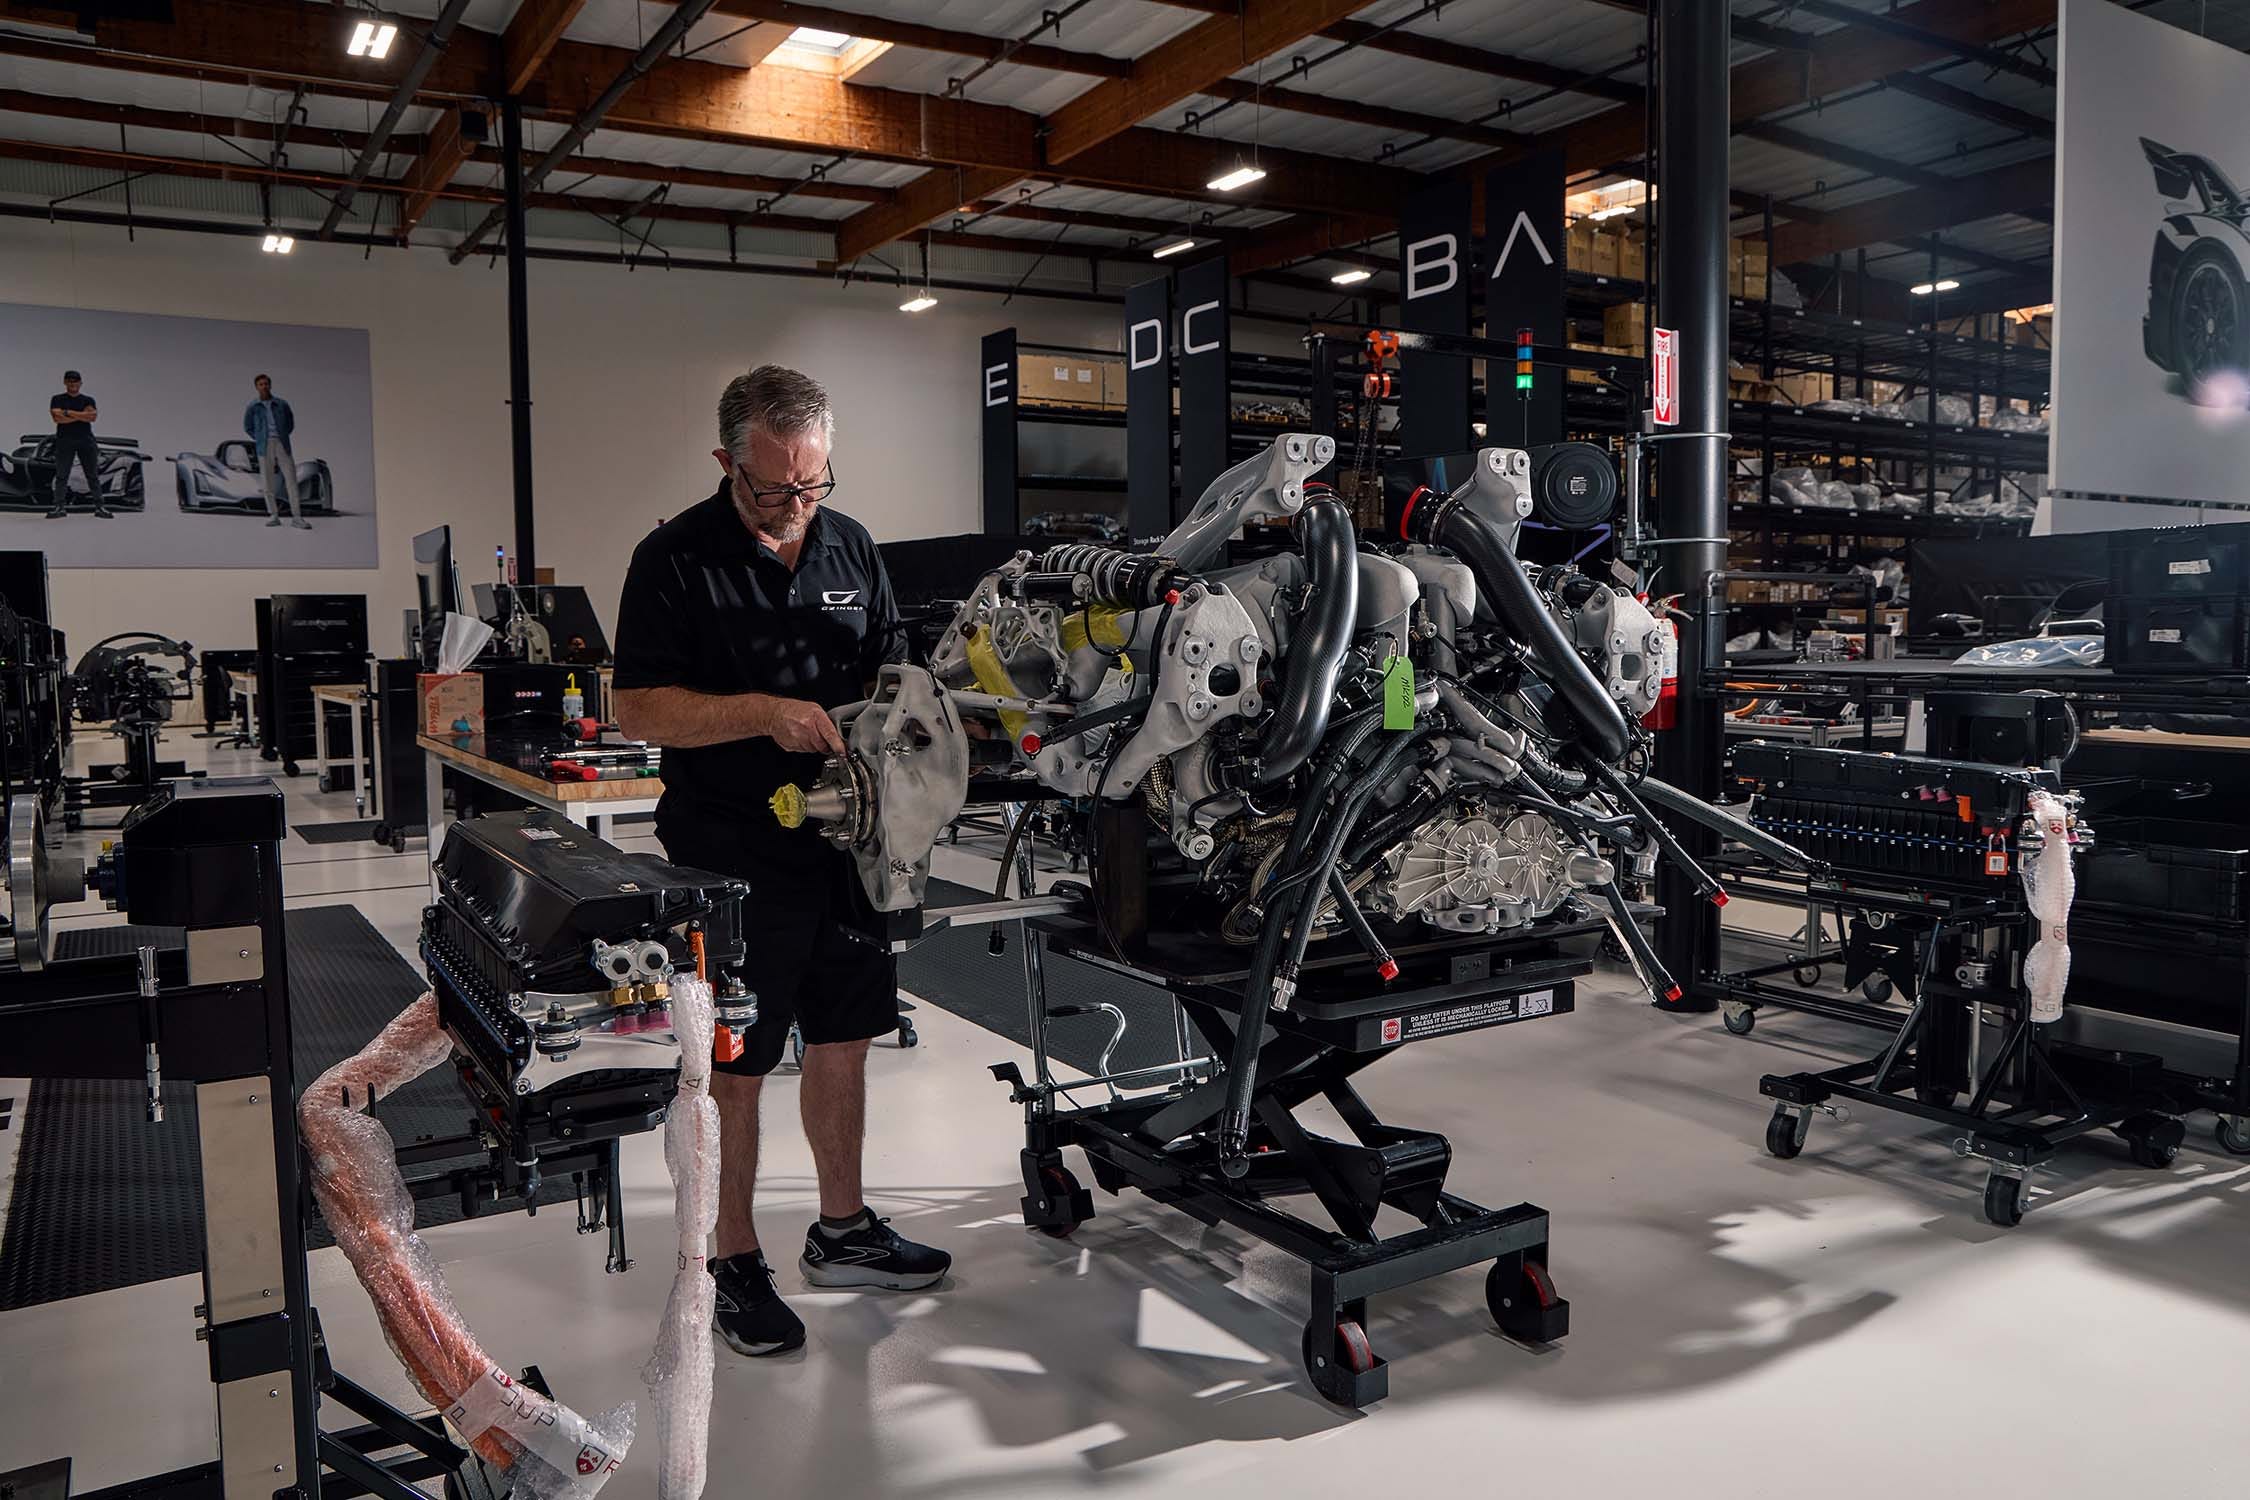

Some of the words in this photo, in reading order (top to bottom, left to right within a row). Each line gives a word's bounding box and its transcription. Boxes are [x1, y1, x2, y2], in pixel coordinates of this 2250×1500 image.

[1407, 234, 1458, 300] B
[1130, 318, 1162, 371] D
[1183, 300, 1220, 355] C
[985, 362, 1009, 408] E
[1385, 1026, 1397, 1035] STOP
[1412, 1018, 1433, 1027] UNLESS
[1447, 1008, 1486, 1021] MECHANICALLY
[1488, 1004, 1509, 1014] LOCKED
[1432, 1009, 1450, 1018] ENTER
[1451, 1006, 1469, 1015] UNDER
[1483, 999, 1510, 1009] PLATFORM
